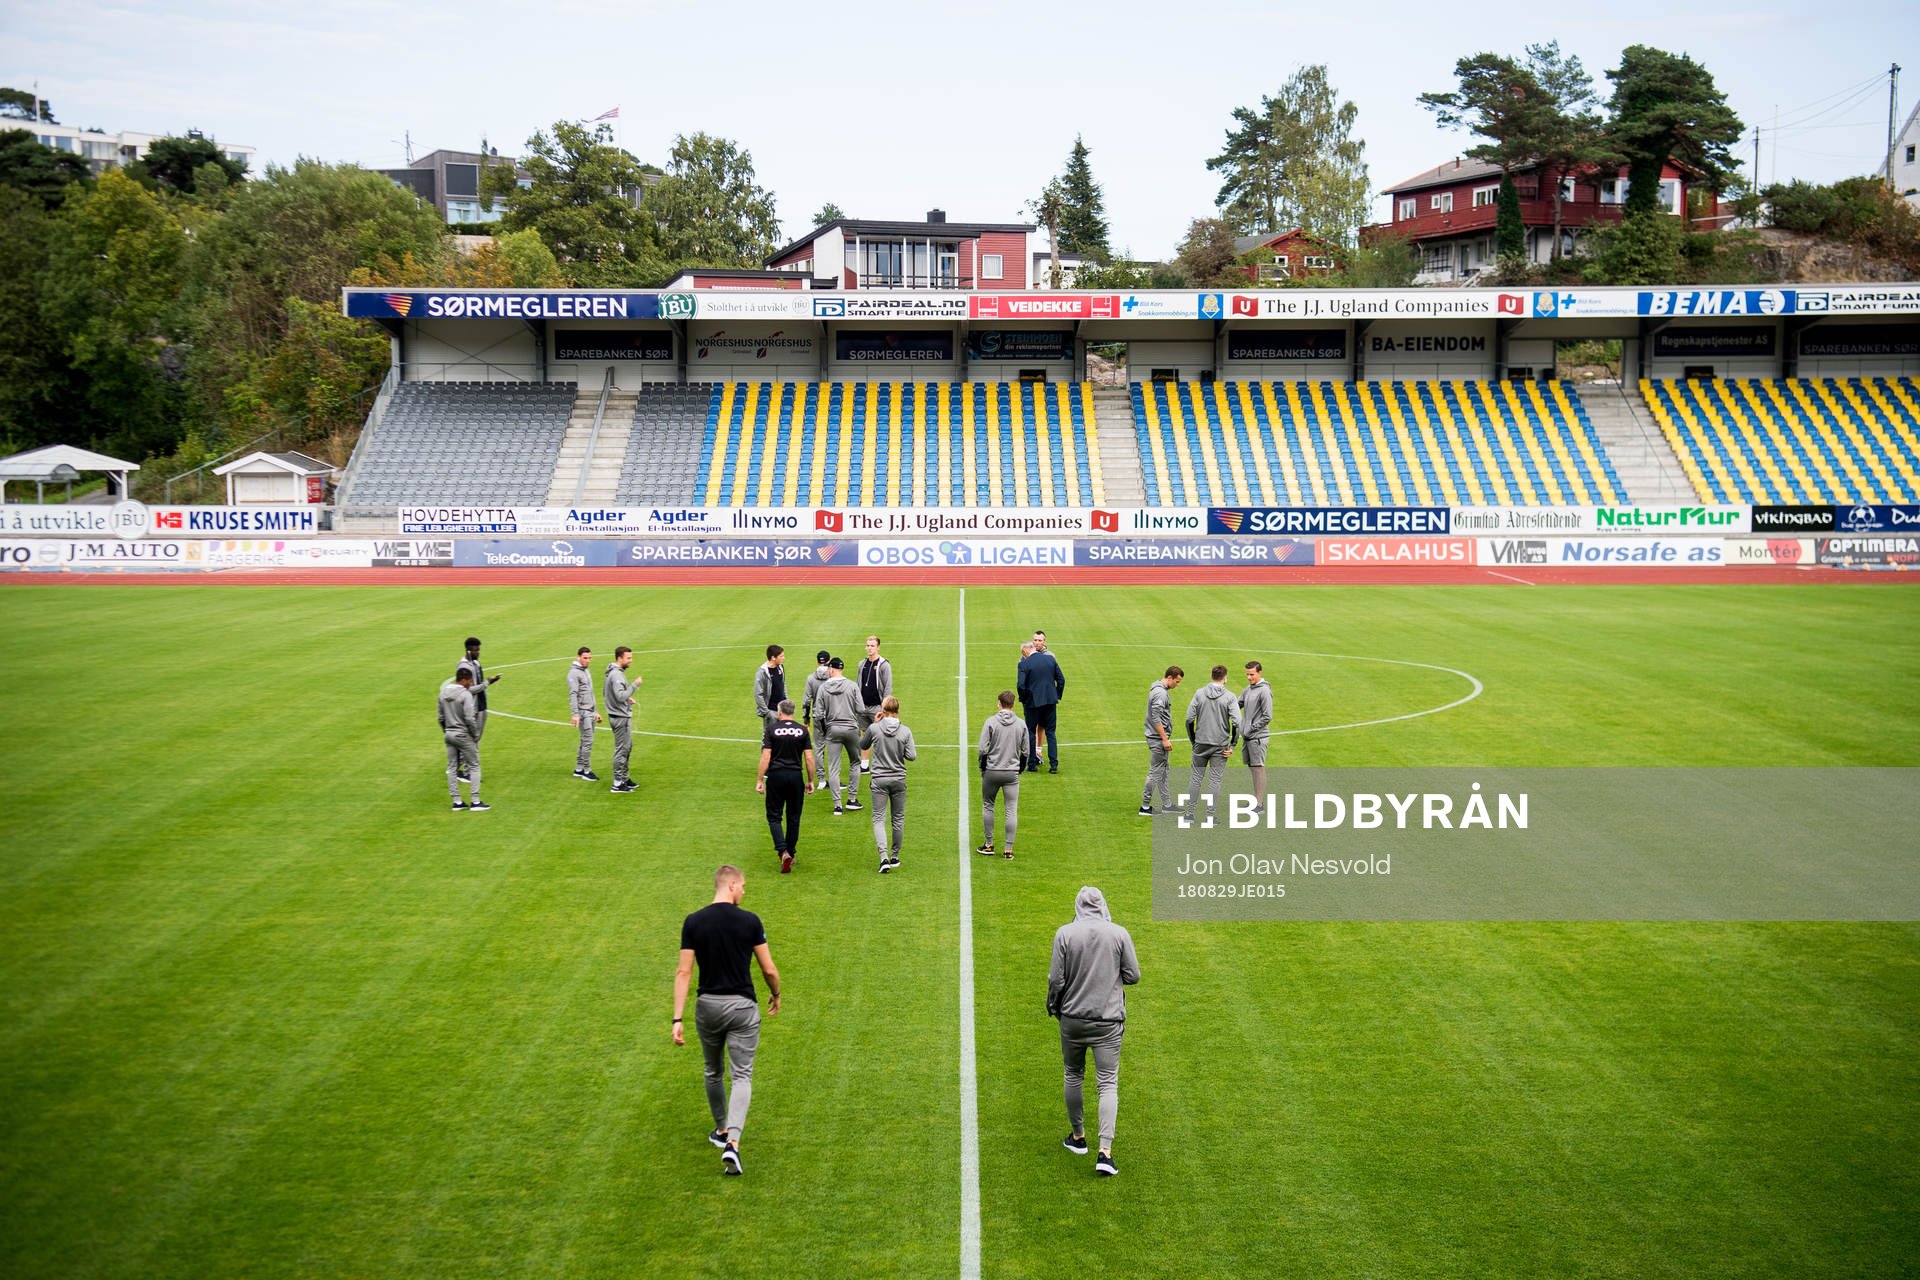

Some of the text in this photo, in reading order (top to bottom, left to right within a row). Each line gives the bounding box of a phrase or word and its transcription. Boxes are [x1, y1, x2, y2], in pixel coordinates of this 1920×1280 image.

[427, 296, 627, 317] SØRMEGLEREN
[706, 302, 742, 313] Stolthet
[757, 302, 788, 312] utvikle
[1007, 301, 1082, 313] VEIDEKKE
[1240, 301, 1250, 312] U
[1265, 298, 1489, 317] The J.J. Ugland Companies
[1505, 298, 1516, 311] U
[1649, 292, 1749, 315] BEMA
[696, 338, 753, 347] NORGESHUS
[754, 338, 811, 347] NORGESHUS
[1372, 337, 1485, 351] BA-EIENDOM
[1755, 335, 1768, 344] AS
[560, 349, 668, 358] SPAREBANKEN SØR
[850, 350, 943, 360] SØRMEGLEREN
[1233, 349, 1342, 358] SPAREBANKEN SØR
[1804, 344, 1918, 354] SPAREBANKEN SØR
[13, 508, 22, 528] å
[30, 510, 105, 529] utvikle
[114, 511, 145, 528] JBU
[190, 511, 312, 531] KRUSE SMITH
[402, 509, 516, 521] HOVDEHYTTA
[566, 509, 626, 524] Agder
[650, 509, 708, 524] Agder
[824, 515, 834, 527] U
[1099, 515, 1110, 527] U
[1250, 511, 1446, 531] SØRMEGLEREN
[1454, 511, 1499, 528] Grimstad
[1597, 508, 1740, 525] NaturMur
[752, 516, 797, 528] NYMO
[850, 514, 1082, 532] The J.J. Ugland Companies
[1153, 516, 1198, 528] NYMO
[113, 543, 179, 557] AUTO
[1329, 543, 1464, 560] SKALAHUS
[1562, 542, 1721, 561] Norsafe as
[1739, 545, 1797, 558] Montér
[1829, 539, 1919, 552] OPTIMERA
[208, 553, 285, 565] FARGERIKE
[484, 552, 584, 566] TeleComputing
[632, 546, 811, 560] SPAREBANKEN SØR
[866, 547, 1066, 564] OBOS LIGAEN
[1089, 545, 1267, 560] SPAREBANKEN SØR
[774, 728, 803, 737] coop
